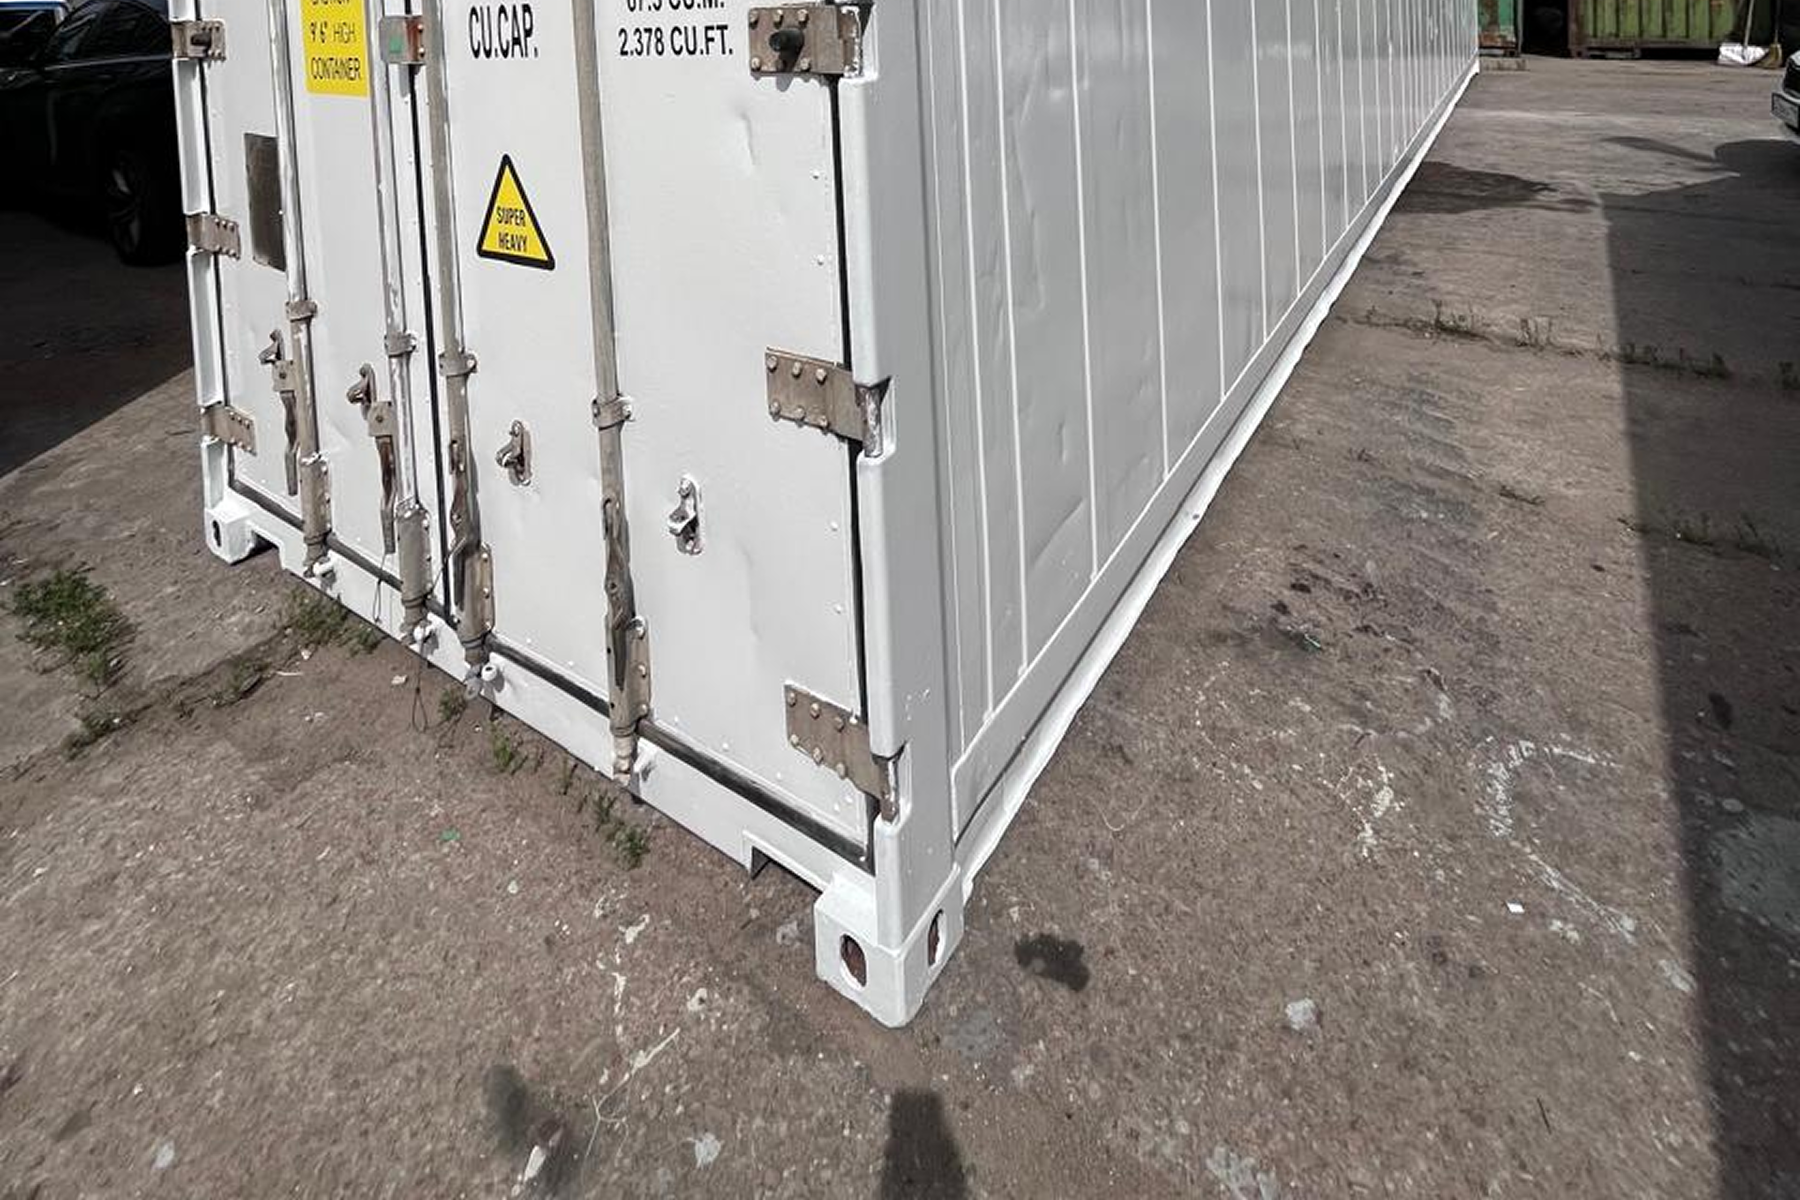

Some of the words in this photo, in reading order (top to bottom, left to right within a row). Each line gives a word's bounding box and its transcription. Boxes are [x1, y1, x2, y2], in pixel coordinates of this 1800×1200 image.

[333, 22, 357, 43] HIGH
[469, 3, 539, 59] CU.CAP.
[618, 27, 664, 56] 2.378
[670, 24, 733, 55] CU.FT.
[311, 57, 362, 80] CONTAINER
[497, 206, 526, 227] SUPER
[498, 231, 527, 252] HEAVY
